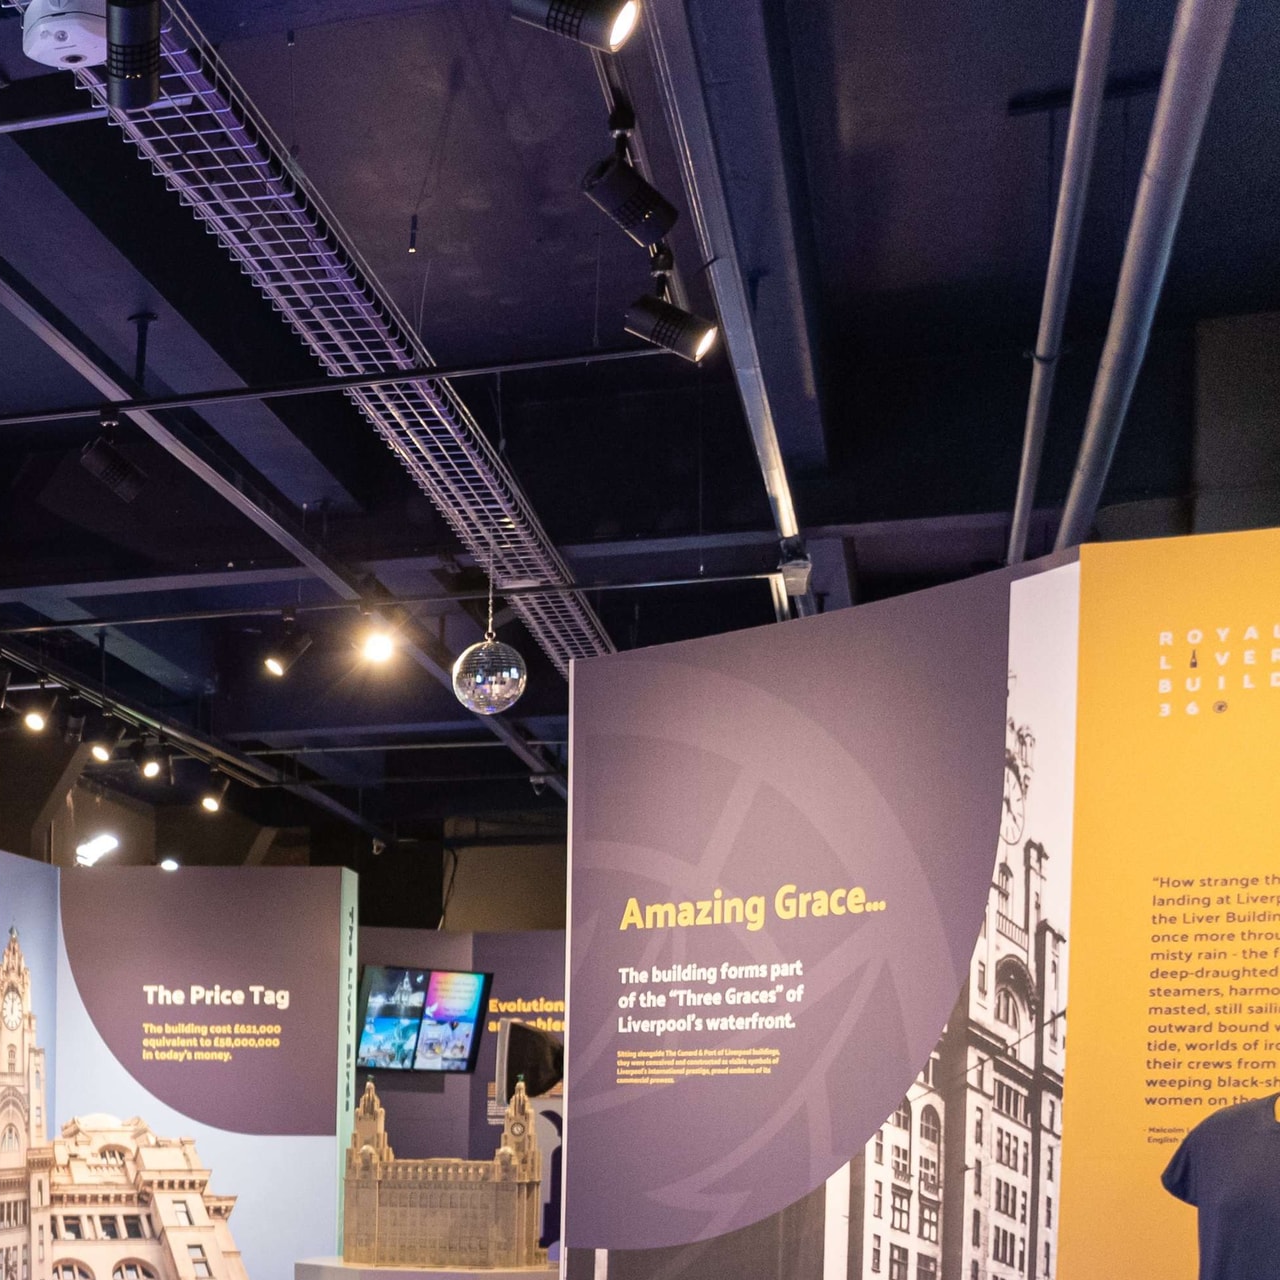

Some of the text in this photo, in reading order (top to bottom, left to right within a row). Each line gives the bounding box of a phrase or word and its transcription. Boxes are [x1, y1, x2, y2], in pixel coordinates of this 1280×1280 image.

[1199, 876, 1259, 889] strange
[618, 883, 887, 931] Amazing Grace...
[1152, 895, 1211, 908] landing
[1216, 894, 1231, 906] at
[1152, 913, 1177, 925] the
[1182, 912, 1220, 925] Liver
[1151, 932, 1189, 943] once
[1194, 931, 1236, 942] more
[1150, 949, 1192, 963] misty
[1197, 949, 1228, 961] rain
[1242, 947, 1269, 960] the
[618, 959, 803, 985] The building forms part
[1149, 967, 1279, 982] deep-draughted
[142, 984, 290, 1010] The Price Tag
[618, 992, 637, 1009] of
[639, 990, 667, 1008] the
[786, 984, 805, 1003] of
[1149, 985, 1224, 998] steamers,
[488, 996, 566, 1013] Evolution
[1148, 1003, 1210, 1016] masted,
[1215, 1003, 1242, 1015] still
[142, 1023, 164, 1034] The
[164, 1022, 209, 1036] building
[209, 1023, 233, 1034] cost
[705, 1012, 796, 1032] waterfront.
[1147, 1021, 1213, 1034] outward
[1218, 1020, 1270, 1033] bound
[142, 1036, 199, 1049] equivalent
[199, 1037, 212, 1047] to
[1147, 1039, 1181, 1052] tide,
[1185, 1039, 1238, 1051] worlds
[1242, 1039, 1259, 1051] of
[193, 1051, 233, 1063] money.
[1146, 1057, 1277, 1070] their crews from
[1145, 1076, 1212, 1091] weeping
[1144, 1095, 1203, 1106] women
[1207, 1095, 1228, 1106] on
